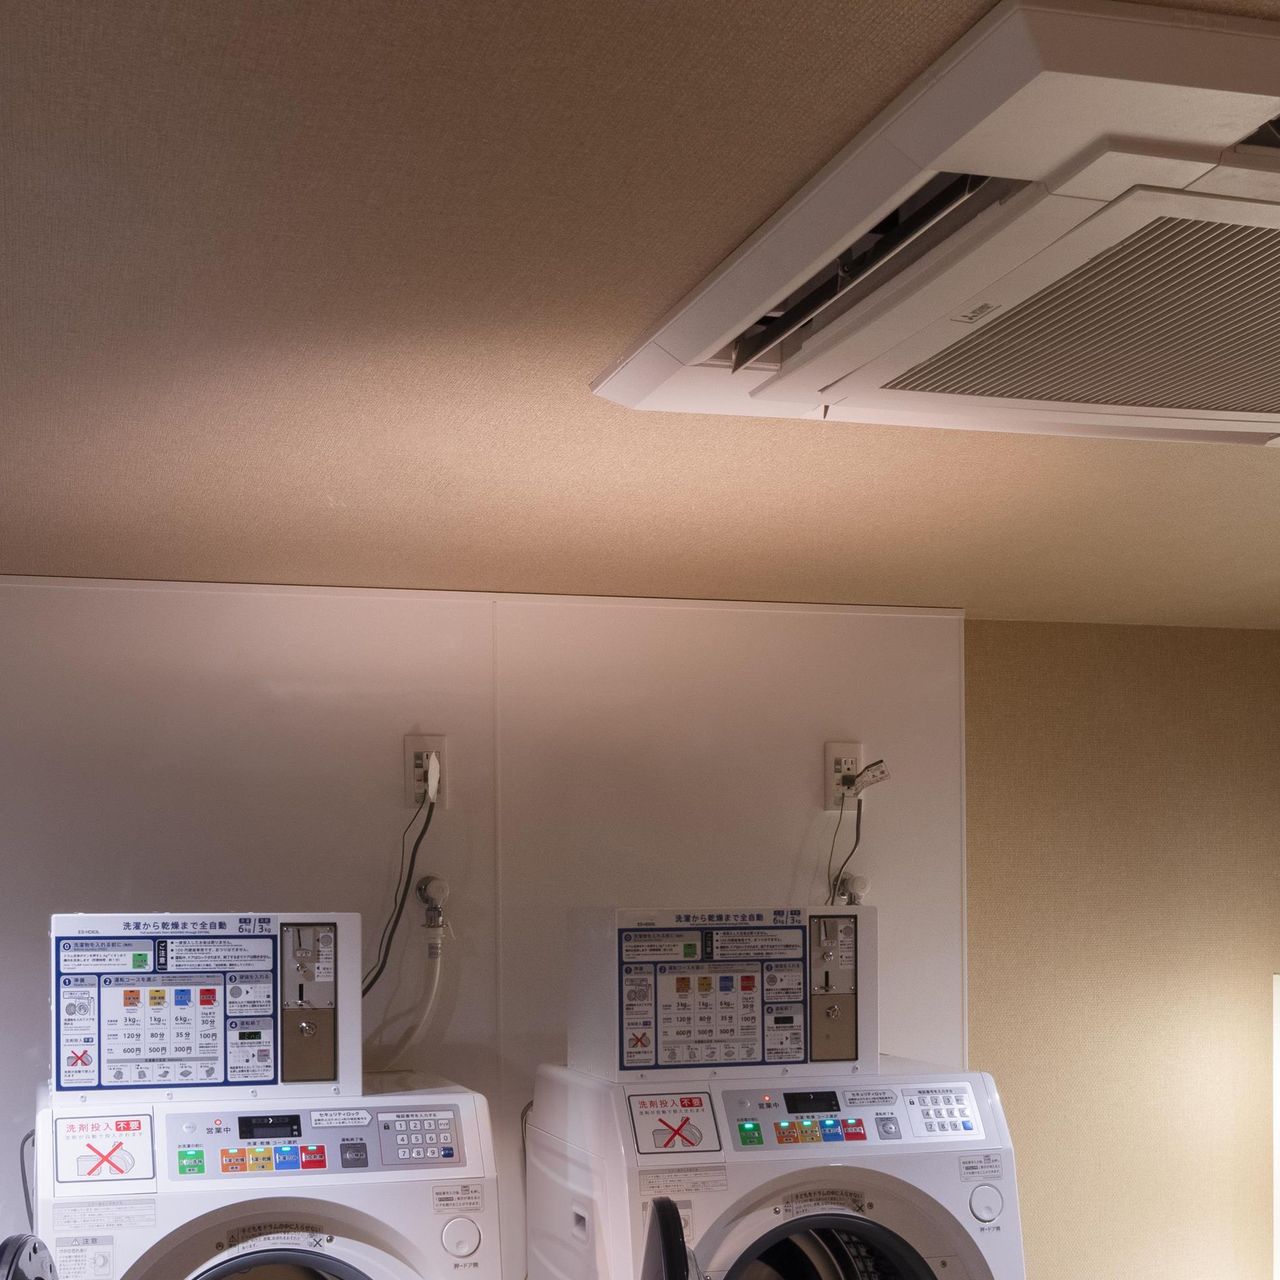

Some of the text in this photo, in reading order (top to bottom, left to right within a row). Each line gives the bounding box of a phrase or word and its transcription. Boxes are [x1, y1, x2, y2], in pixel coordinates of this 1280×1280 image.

[675, 913, 764, 923] 洗濯から乾燥まで全自動
[123, 921, 227, 931] 洗濯から乾燥まで全自動
[639, 1097, 703, 1110] 洗剤投入 不要
[758, 1102, 780, 1110] 営業中
[66, 1120, 141, 1134] 洗剤投入 不要
[206, 1127, 231, 1135] 営業中
[83, 1237, 97, 1245] 注意
